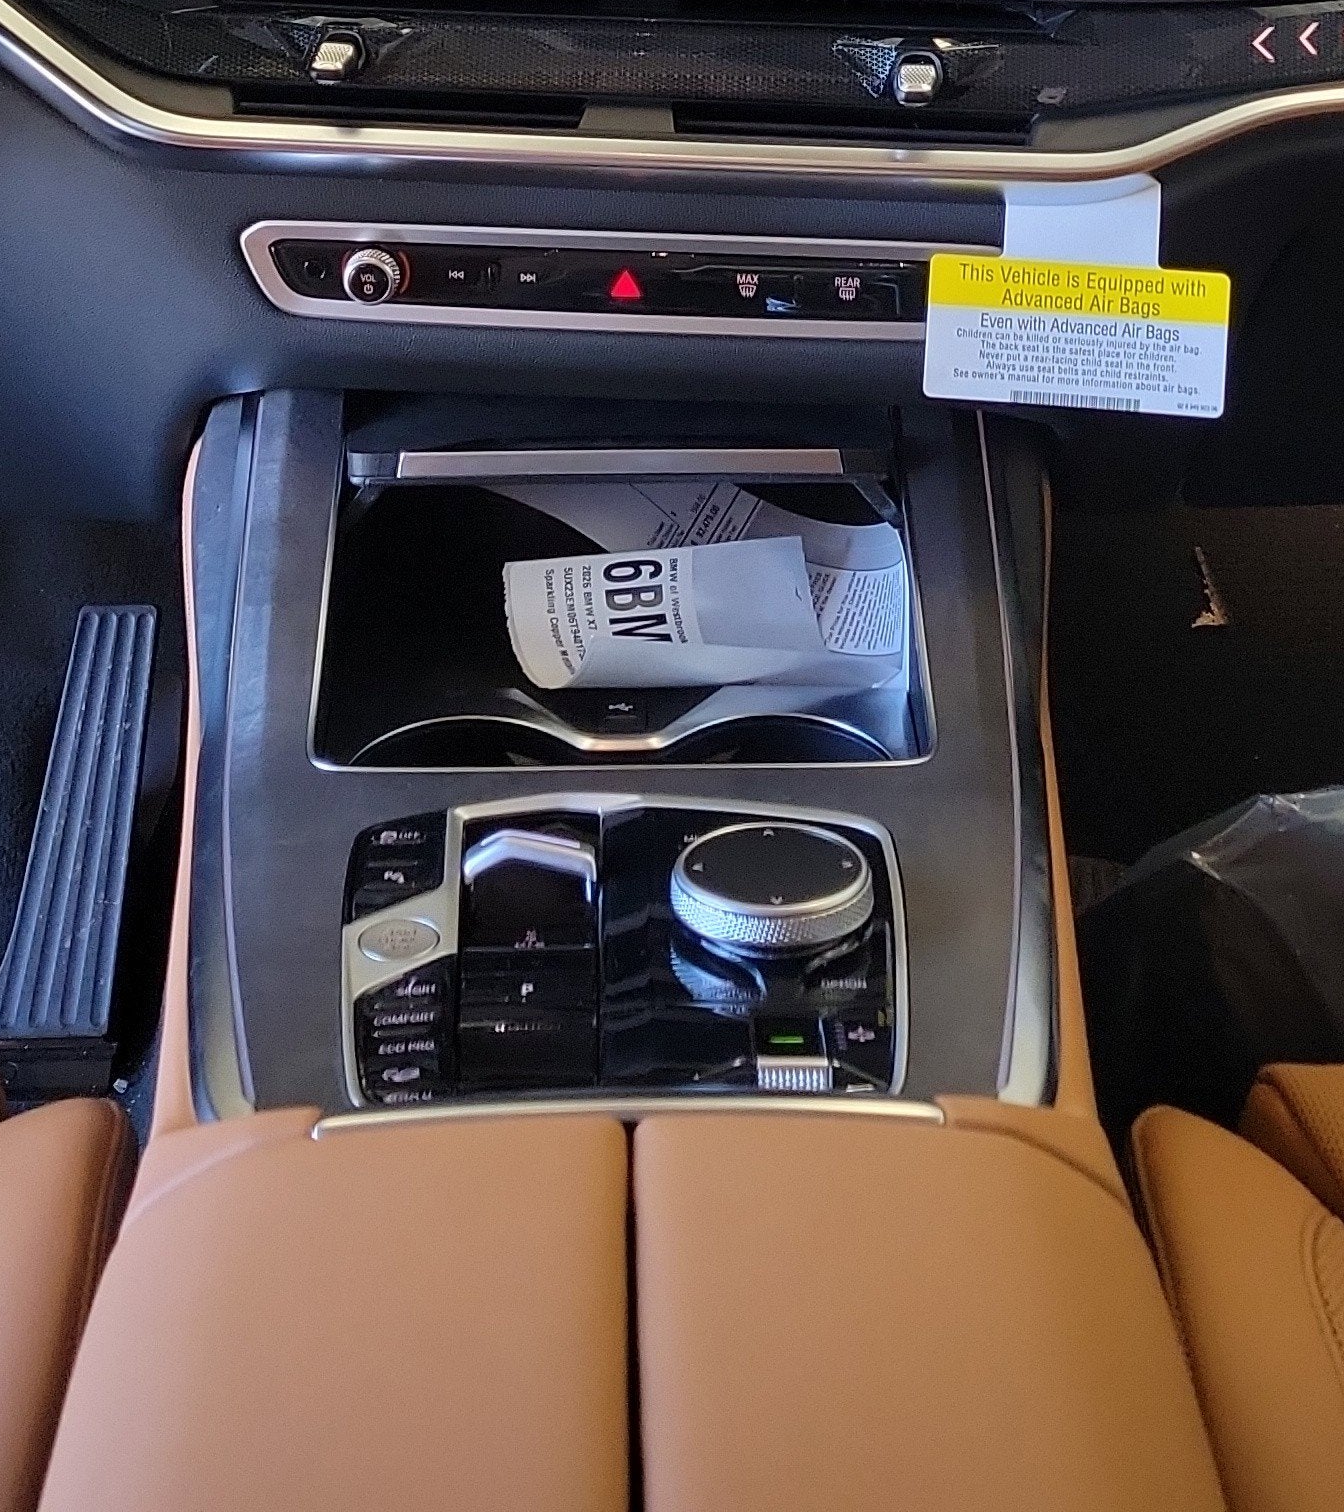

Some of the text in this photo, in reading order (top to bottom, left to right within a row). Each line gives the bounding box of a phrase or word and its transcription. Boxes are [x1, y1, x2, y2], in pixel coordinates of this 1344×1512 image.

[360, 273, 377, 283] VOL
[736, 273, 759, 285] MAX
[835, 276, 861, 288] REAR
[959, 263, 1206, 297] This Vehicle is Equipped with
[1001, 288, 1161, 318] Advanced Air Bags
[980, 312, 1180, 344] Even with Advanced Air Bags
[956, 327, 1202, 356] Children can be killed or seriously injured by the air bag.
[981, 339, 1176, 363] The back seat is the safest place for children.
[979, 349, 1176, 373] Never put a rear-facing child seat in the front.
[986, 360, 1168, 382] Always use seat belts and child restraints.
[953, 368, 1200, 396] See owner's manual for more information about air bags.
[669, 557, 679, 583] BMW
[582, 565, 598, 631] 2026 BMW X7
[669, 585, 679, 596] of
[544, 568, 564, 649] Sparkling Copper
